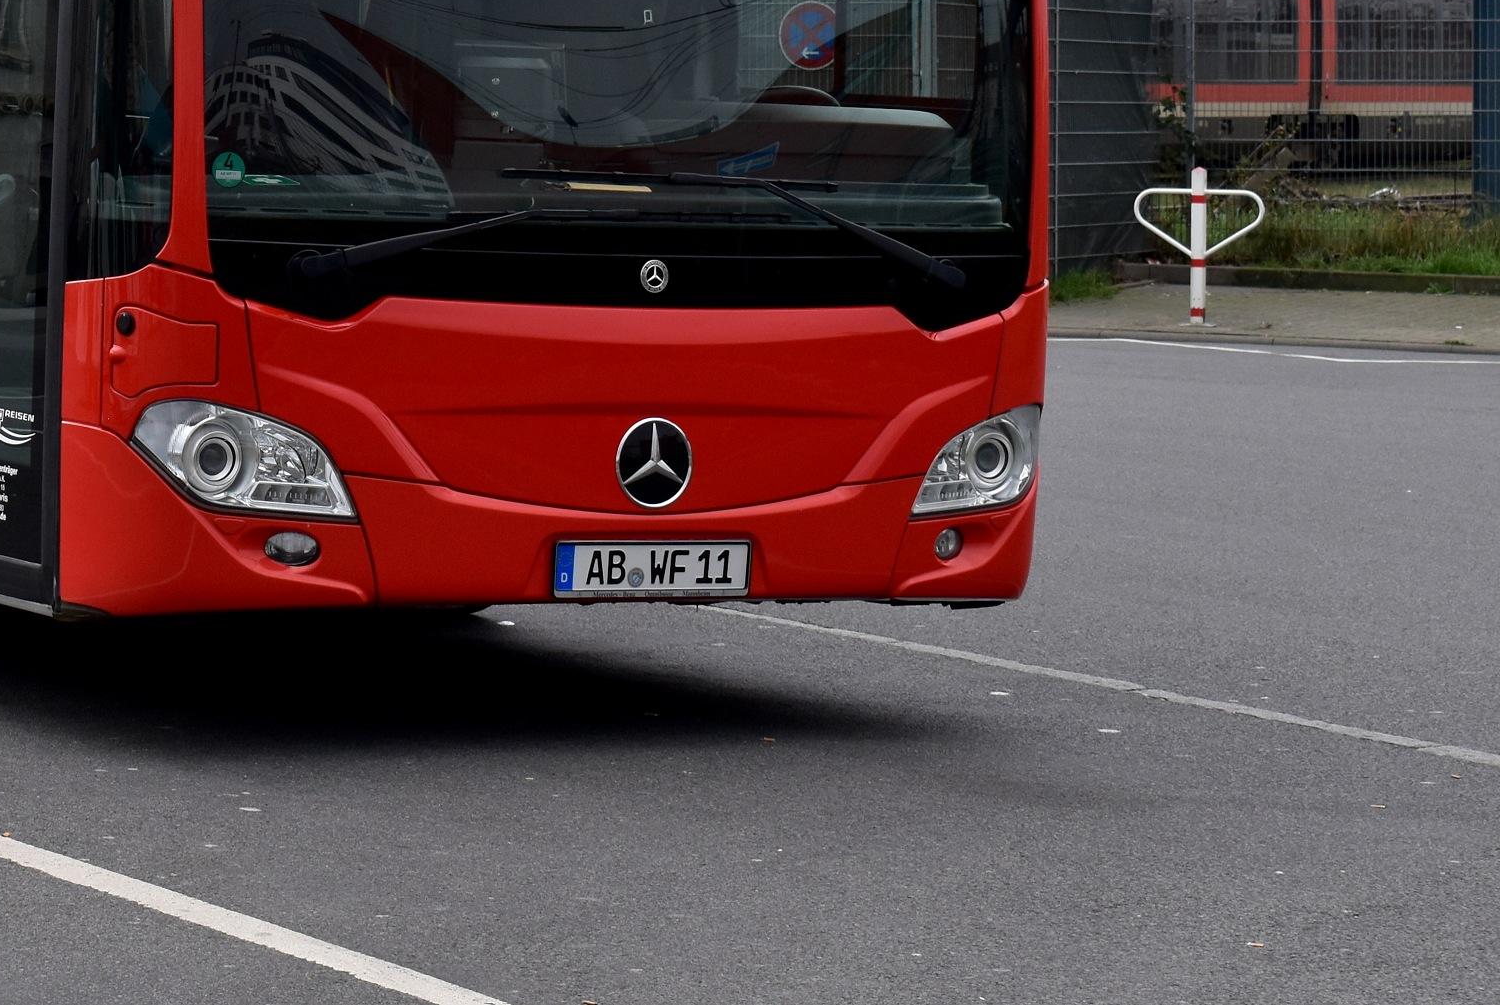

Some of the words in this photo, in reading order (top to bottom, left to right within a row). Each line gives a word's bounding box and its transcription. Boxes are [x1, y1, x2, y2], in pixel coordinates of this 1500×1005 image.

[224, 153, 234, 170] 4
[4, 409, 35, 423] REISEN
[560, 572, 568, 584] D
[585, 549, 627, 586] AB
[649, 549, 690, 586] WF
[695, 548, 733, 585] 11
